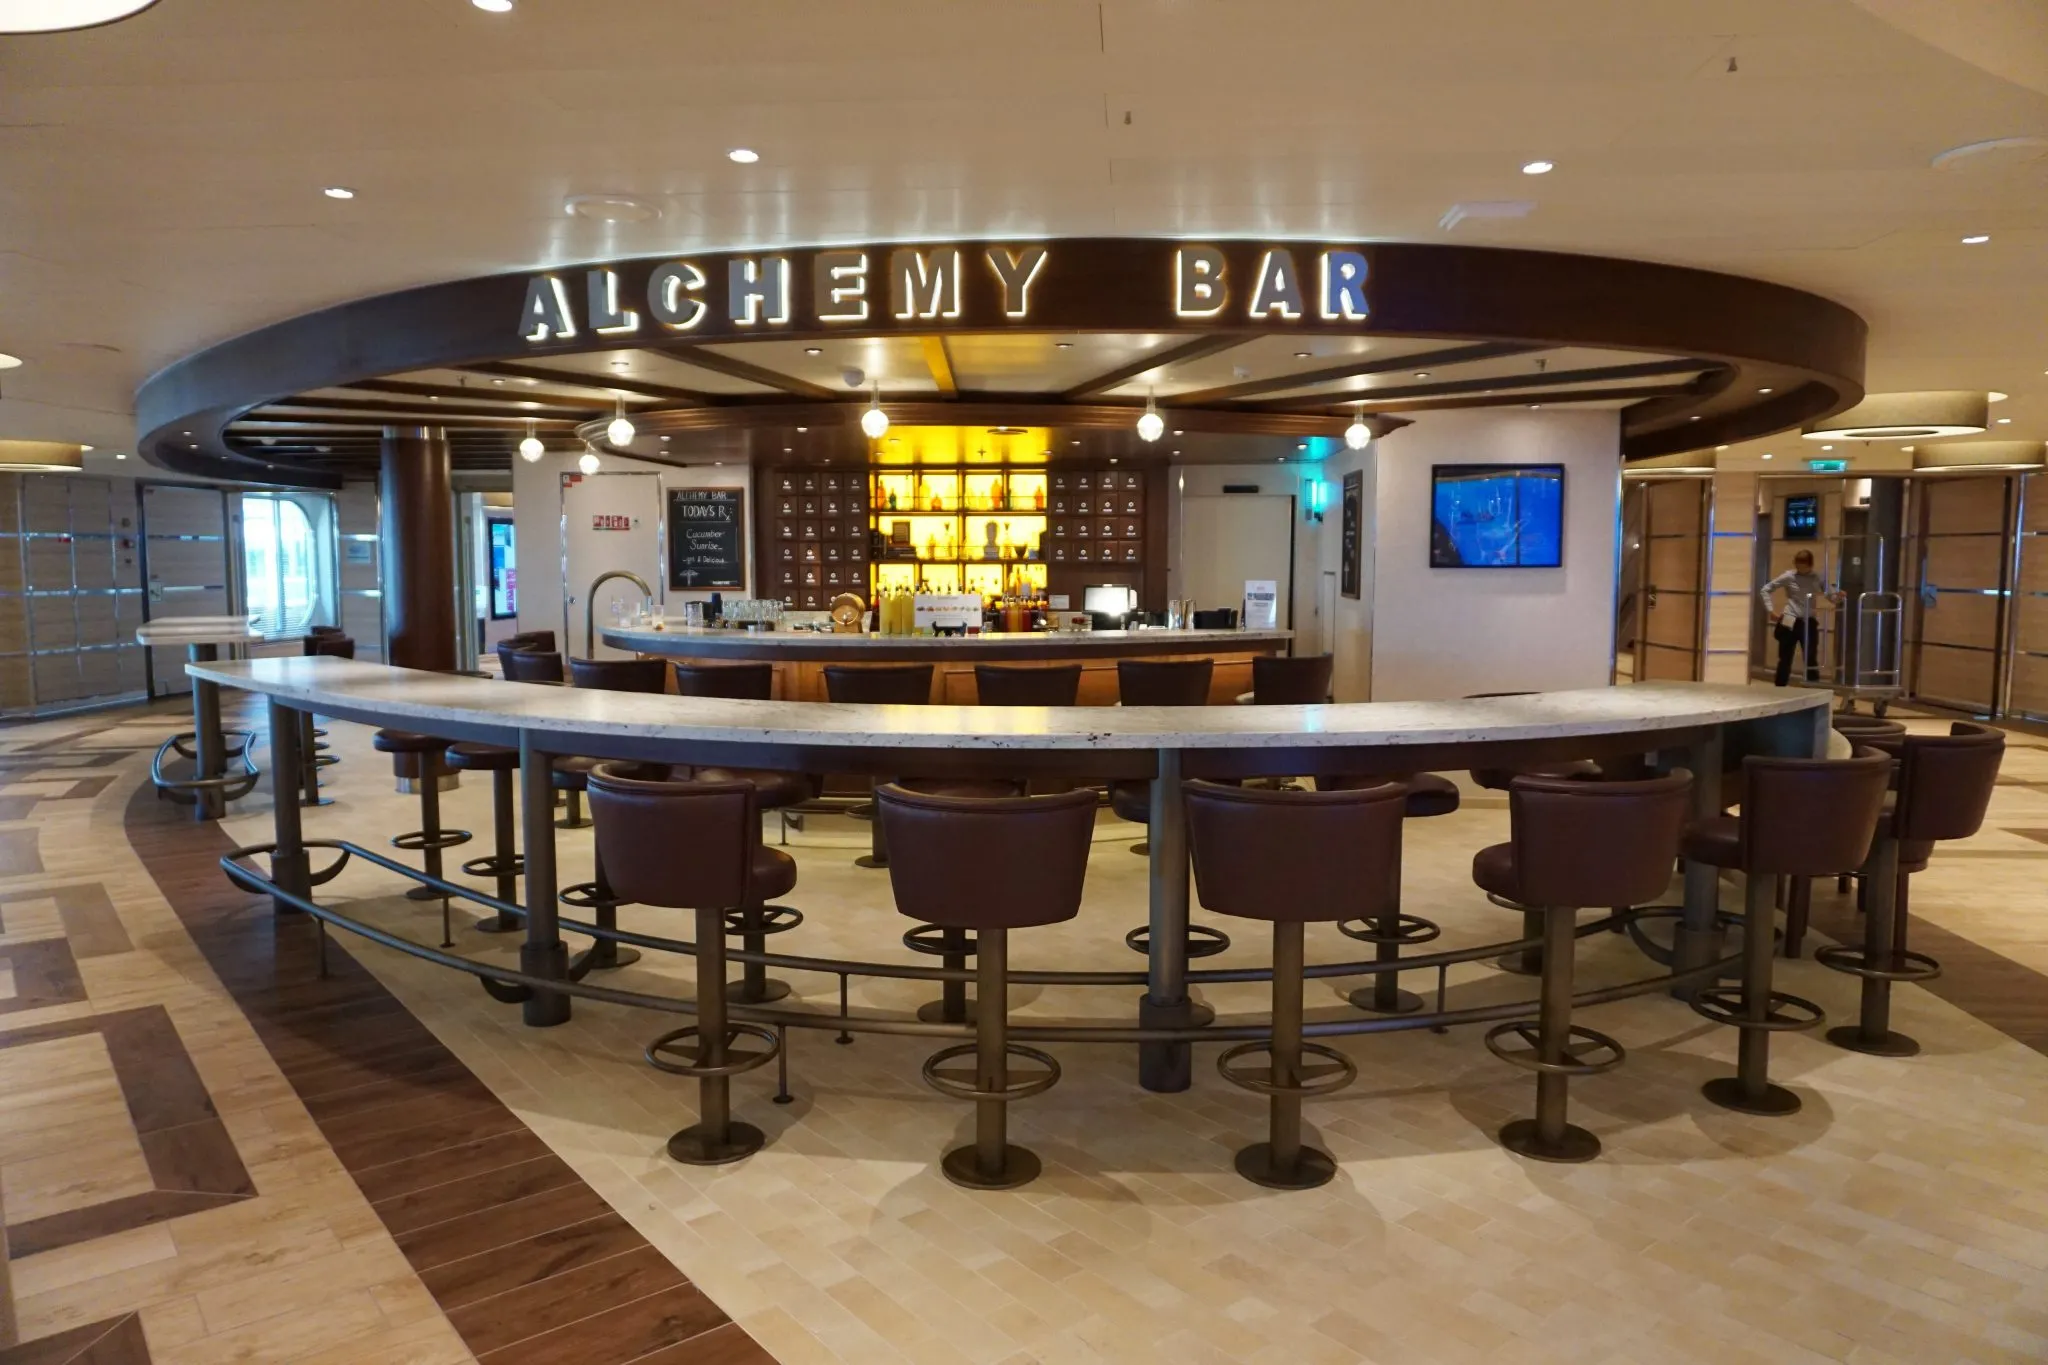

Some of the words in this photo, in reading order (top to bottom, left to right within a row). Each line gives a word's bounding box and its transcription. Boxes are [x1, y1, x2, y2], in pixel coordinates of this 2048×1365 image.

[518, 247, 1047, 341] ALCHEMY
[1177, 248, 1370, 319] BAR
[711, 490, 727, 500] BAR
[686, 528, 725, 539] Cucumber
